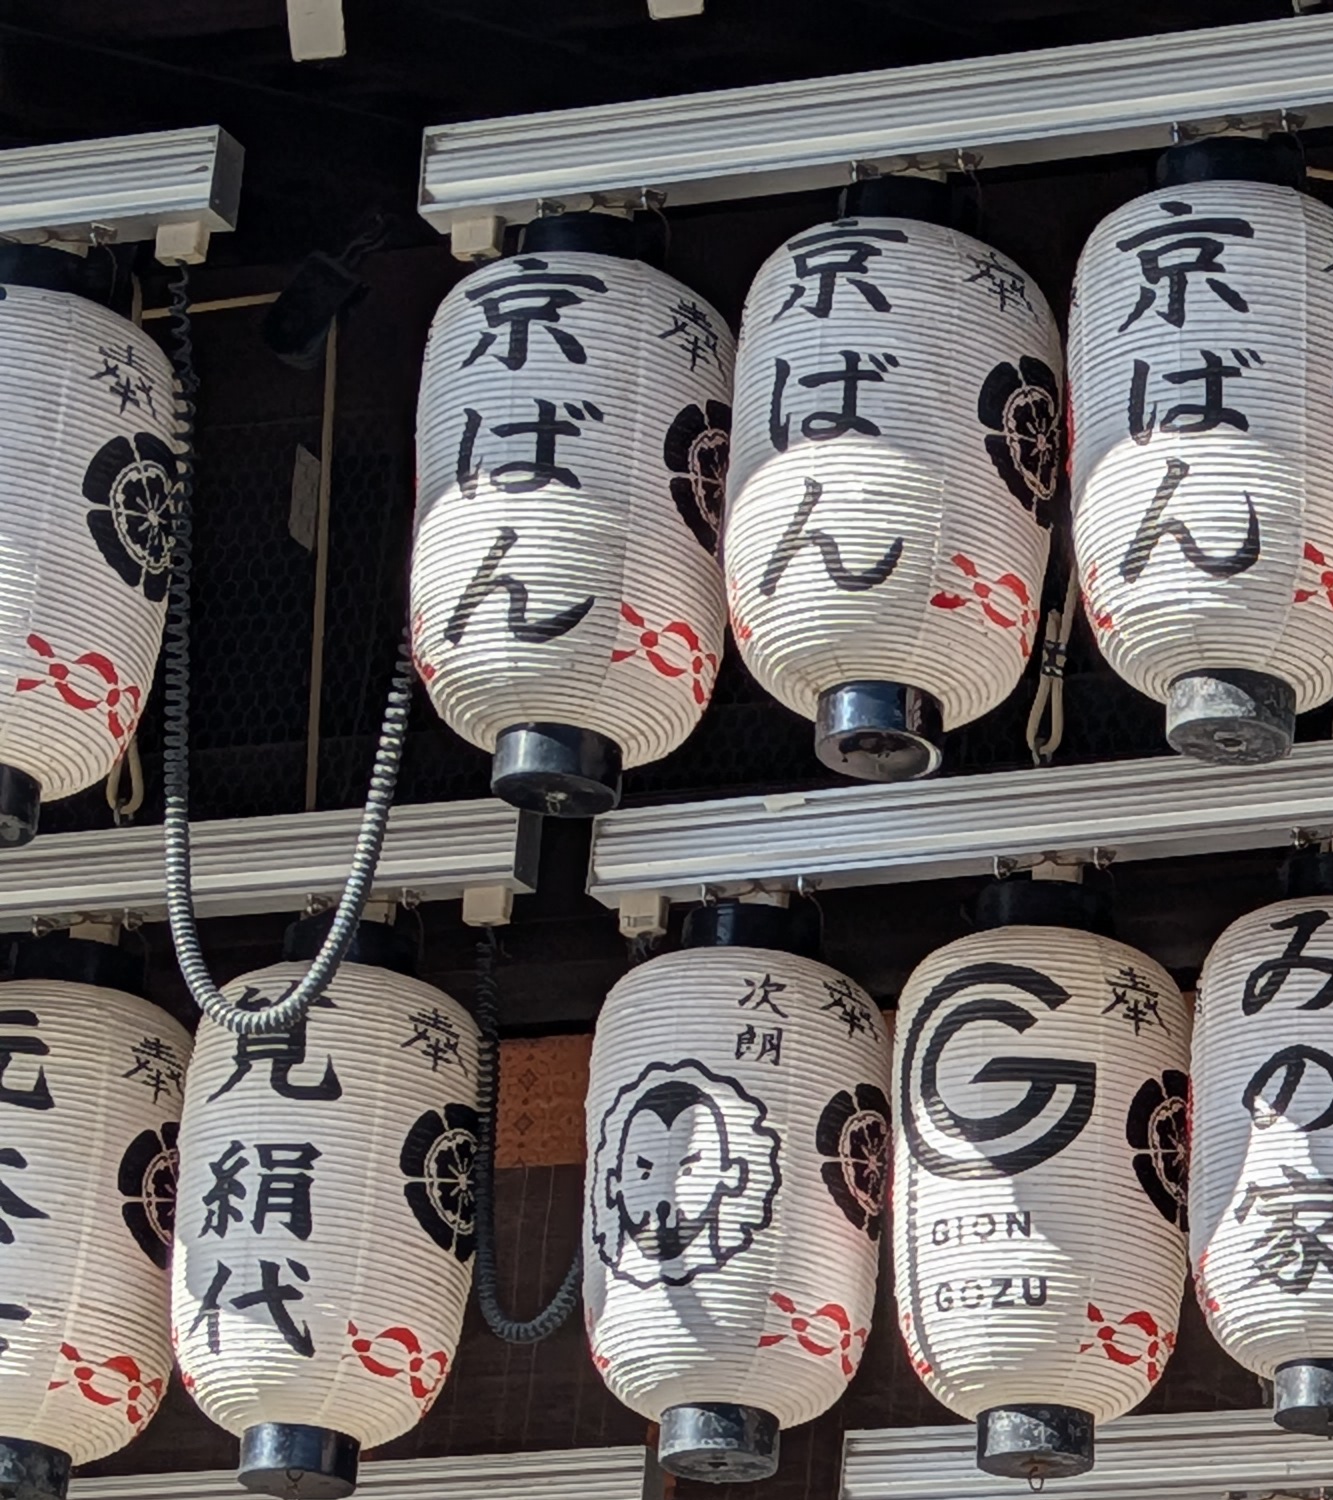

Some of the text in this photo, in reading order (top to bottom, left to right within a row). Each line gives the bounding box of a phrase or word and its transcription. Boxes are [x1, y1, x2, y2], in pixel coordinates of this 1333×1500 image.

[445, 259, 607, 647] 京ばん
[759, 219, 908, 597] 京ばん
[1117, 202, 1266, 584] 京ばん
[735, 973, 789, 1066] 次朗
[932, 1211, 1031, 1246] GION
[935, 1277, 1048, 1312] GOZU
